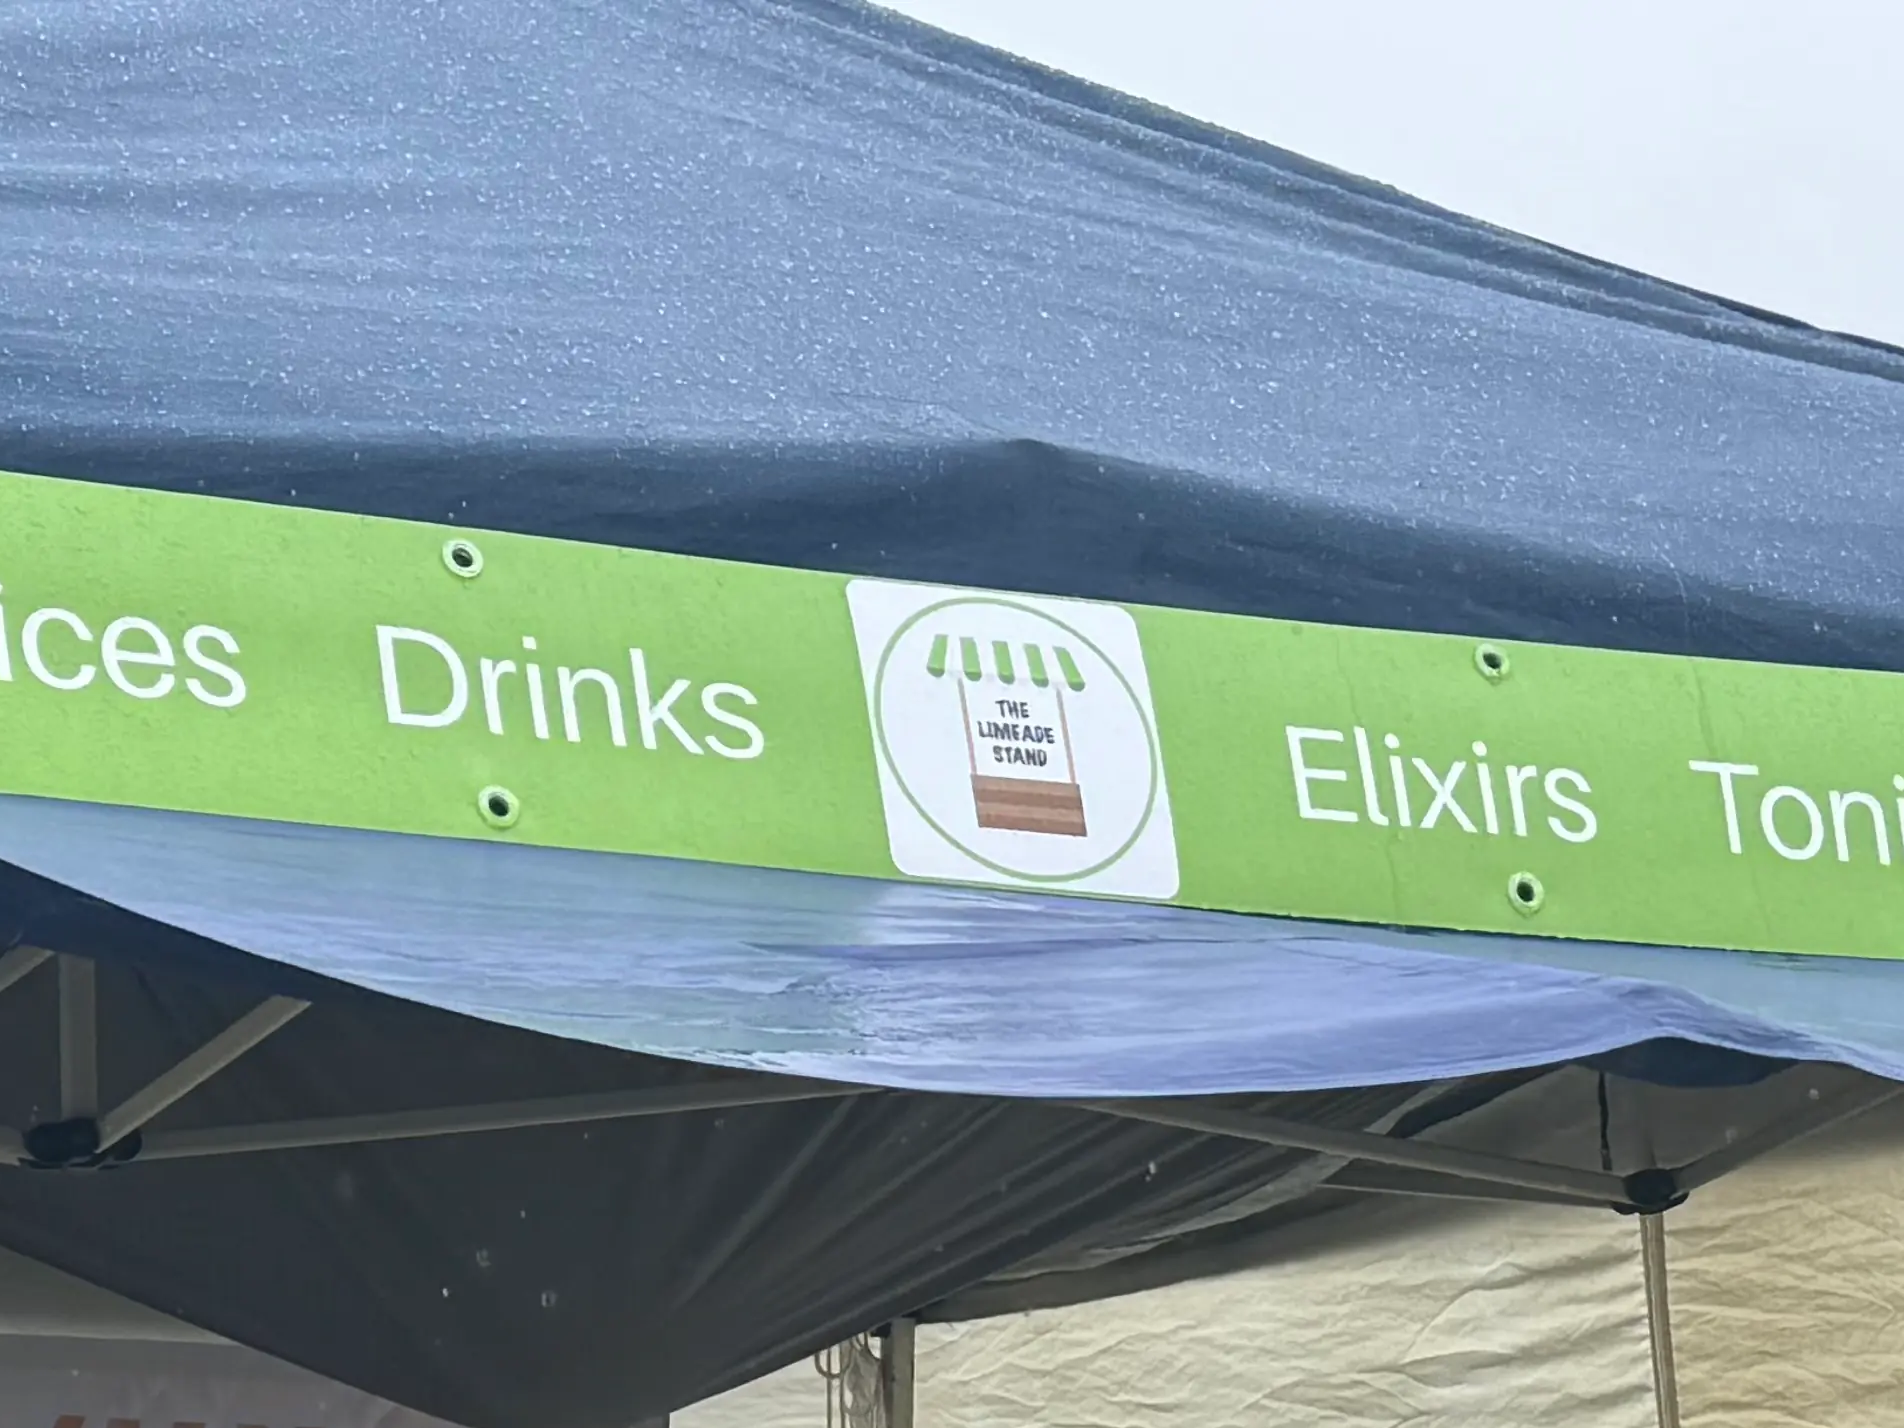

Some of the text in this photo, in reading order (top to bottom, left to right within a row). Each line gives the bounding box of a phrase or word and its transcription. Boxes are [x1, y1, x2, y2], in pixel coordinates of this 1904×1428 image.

[376, 625, 764, 758] Drinks
[996, 700, 1029, 718] THE
[977, 721, 1055, 744] LIMEADE
[993, 746, 1047, 766] STAND
[1286, 726, 1597, 842] Elixirs
